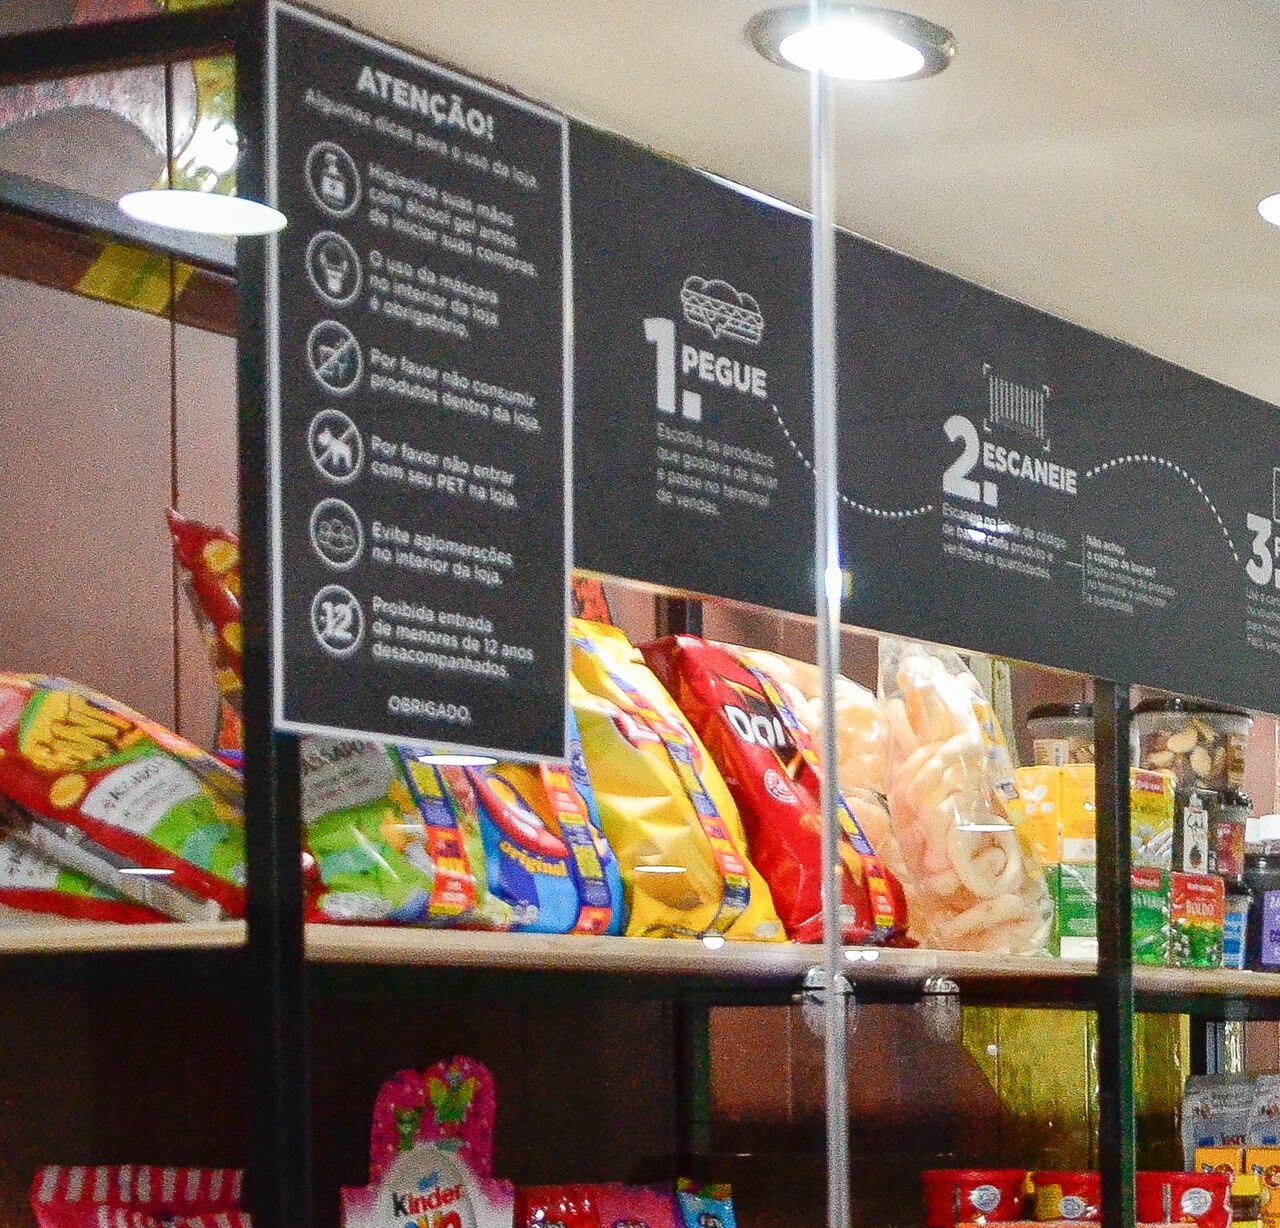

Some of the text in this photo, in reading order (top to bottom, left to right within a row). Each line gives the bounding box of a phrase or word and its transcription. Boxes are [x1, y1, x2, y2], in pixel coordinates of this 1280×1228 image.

[357, 65, 495, 141] ATENÇÃO!
[368, 187, 402, 208] com
[453, 215, 476, 235] gel
[478, 225, 518, 250] antes
[441, 190, 473, 214] suas
[369, 250, 382, 267] O
[386, 258, 414, 278] uso
[441, 233, 473, 256] suas
[369, 274, 389, 292] no
[392, 282, 447, 309] interior
[370, 347, 536, 409] Por favor não consumir
[682, 344, 768, 399] PEGUE
[370, 373, 438, 404] produtos
[441, 391, 489, 417] dentro
[492, 405, 511, 424] da
[371, 434, 515, 486] Por favor não entrar
[371, 460, 404, 480] com
[408, 469, 433, 488] seu
[437, 472, 466, 494] PET
[468, 483, 486, 500] na
[983, 441, 1077, 495] ESCANEIE
[371, 520, 514, 568] Evite aglomerações
[372, 545, 392, 562] no
[395, 548, 449, 571] interior
[452, 561, 471, 579] da
[372, 620, 392, 636] de
[395, 623, 459, 650] menores
[461, 635, 480, 653] de
[483, 638, 499, 655] 12
[502, 642, 534, 662] anos
[438, 608, 493, 634] entrada
[394, 1183, 466, 1216] Kinder
